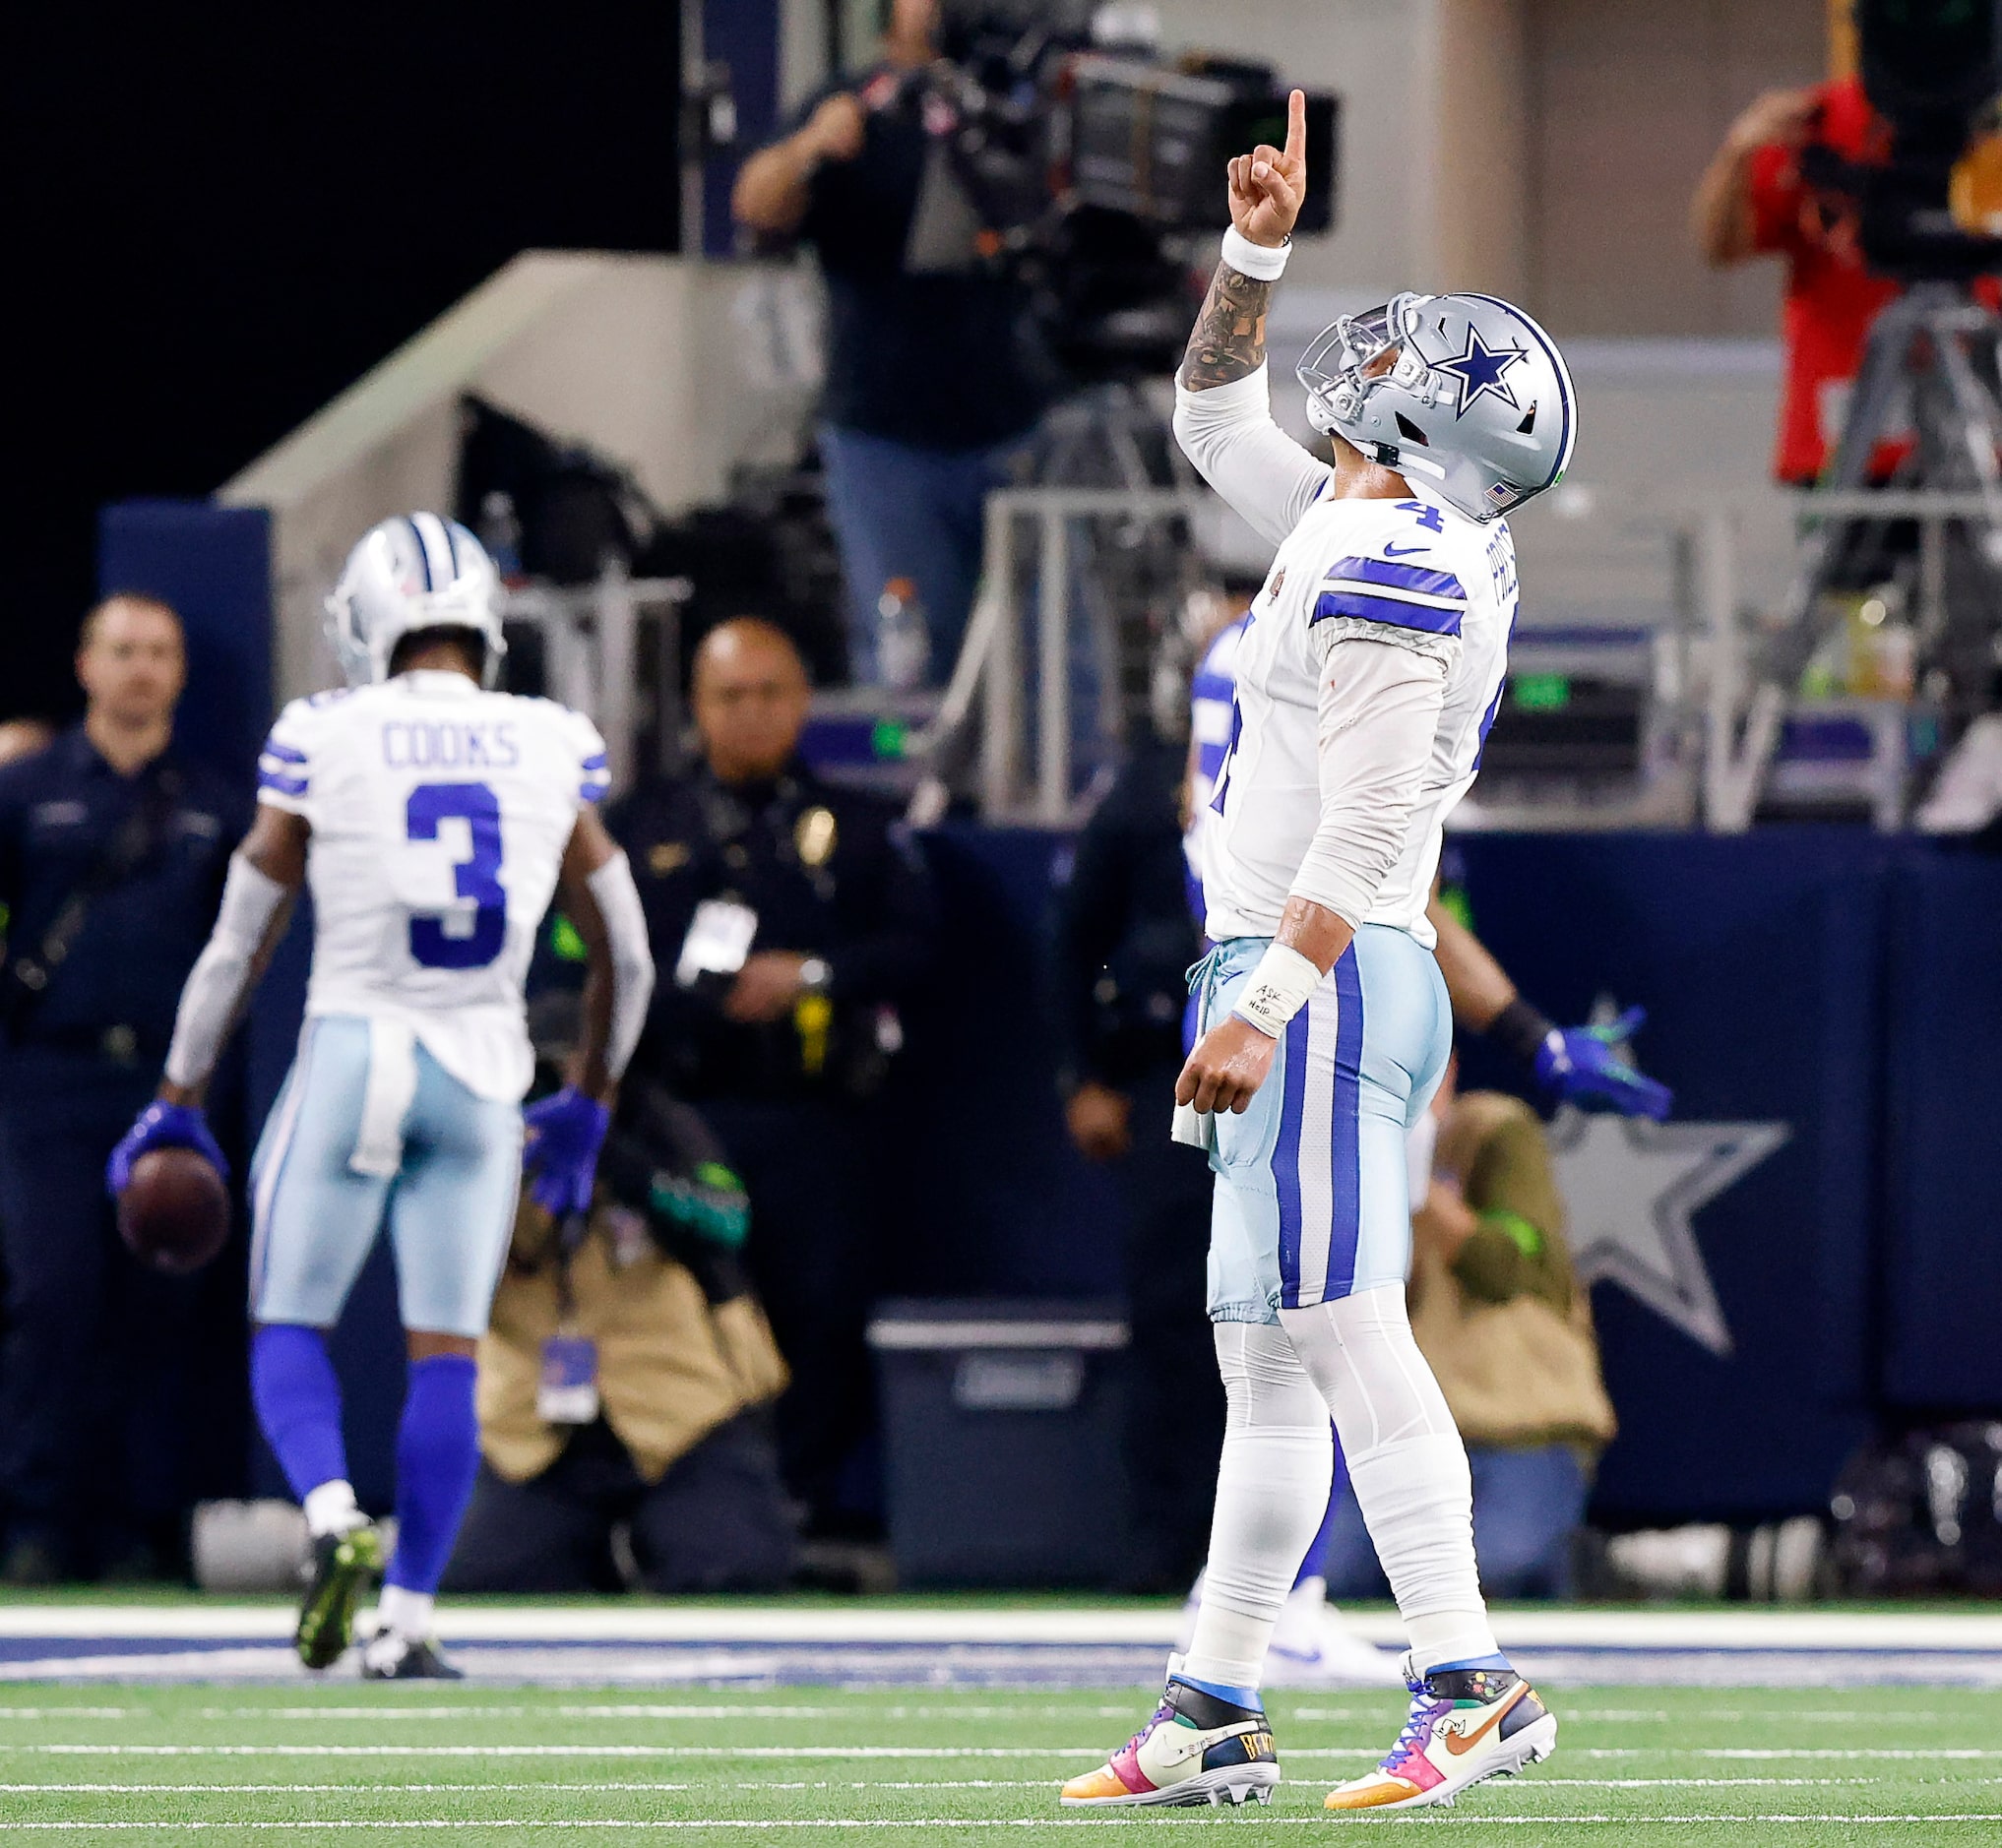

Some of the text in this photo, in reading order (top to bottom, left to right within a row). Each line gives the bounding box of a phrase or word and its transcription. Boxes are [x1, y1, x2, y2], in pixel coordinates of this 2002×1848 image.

[1394, 501, 1444, 533] 4
[382, 723, 518, 768] COOKS
[407, 783, 506, 968] 3
